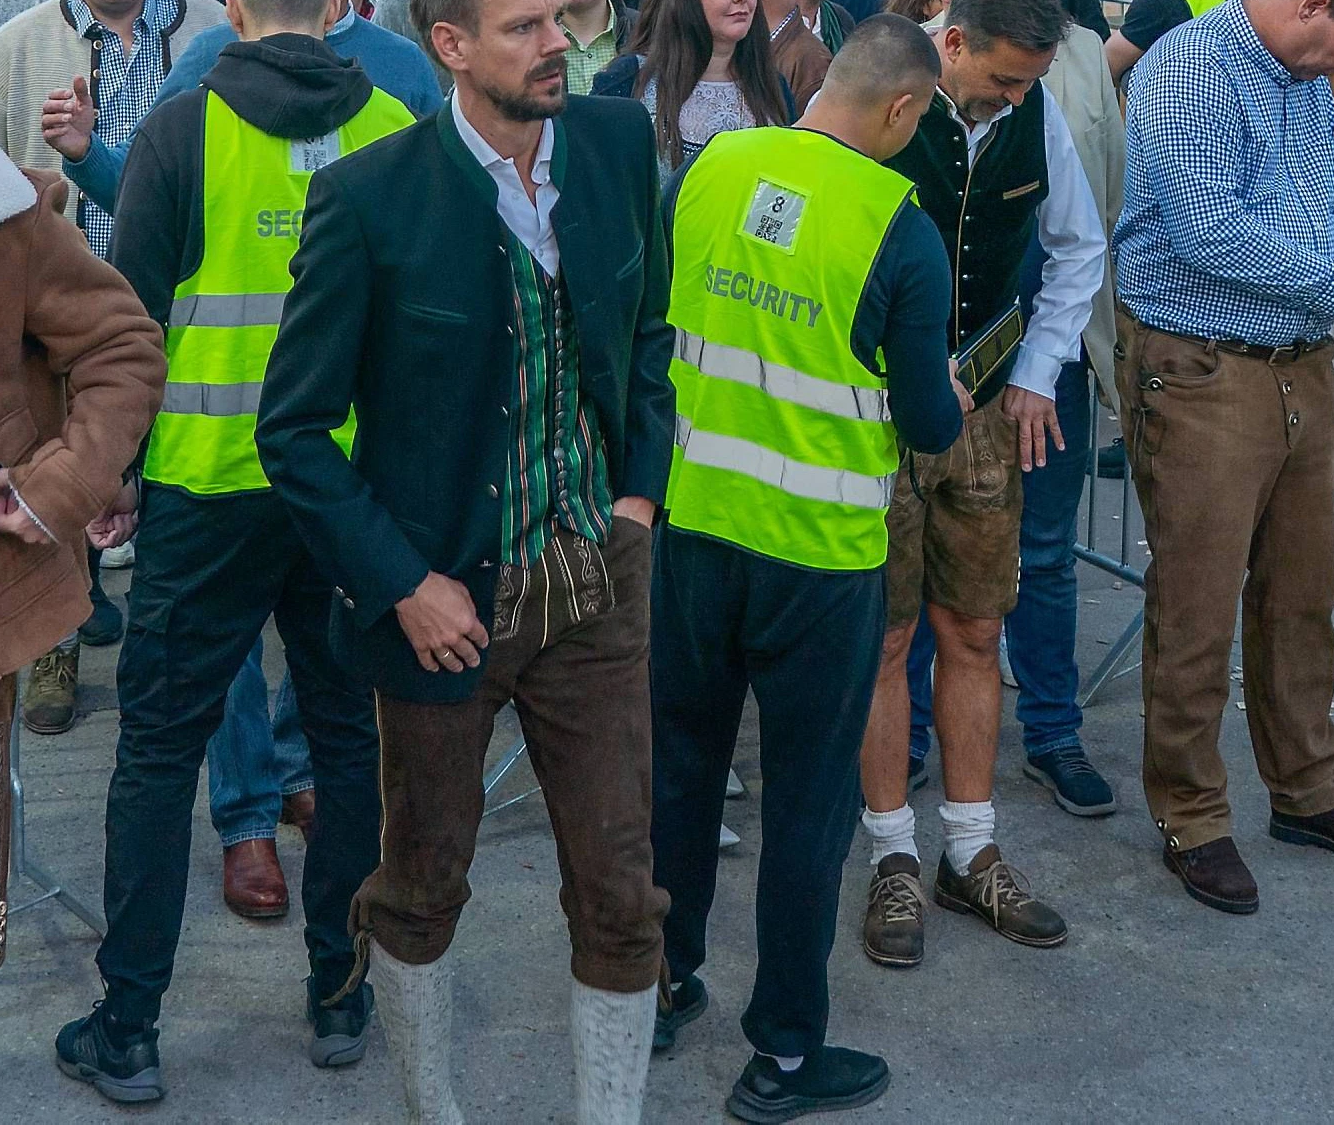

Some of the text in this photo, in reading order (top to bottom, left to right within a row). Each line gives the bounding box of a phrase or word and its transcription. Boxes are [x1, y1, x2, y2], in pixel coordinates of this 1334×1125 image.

[772, 196, 785, 213] 8
[257, 209, 304, 237] SEC
[706, 264, 823, 328] SECURITY
